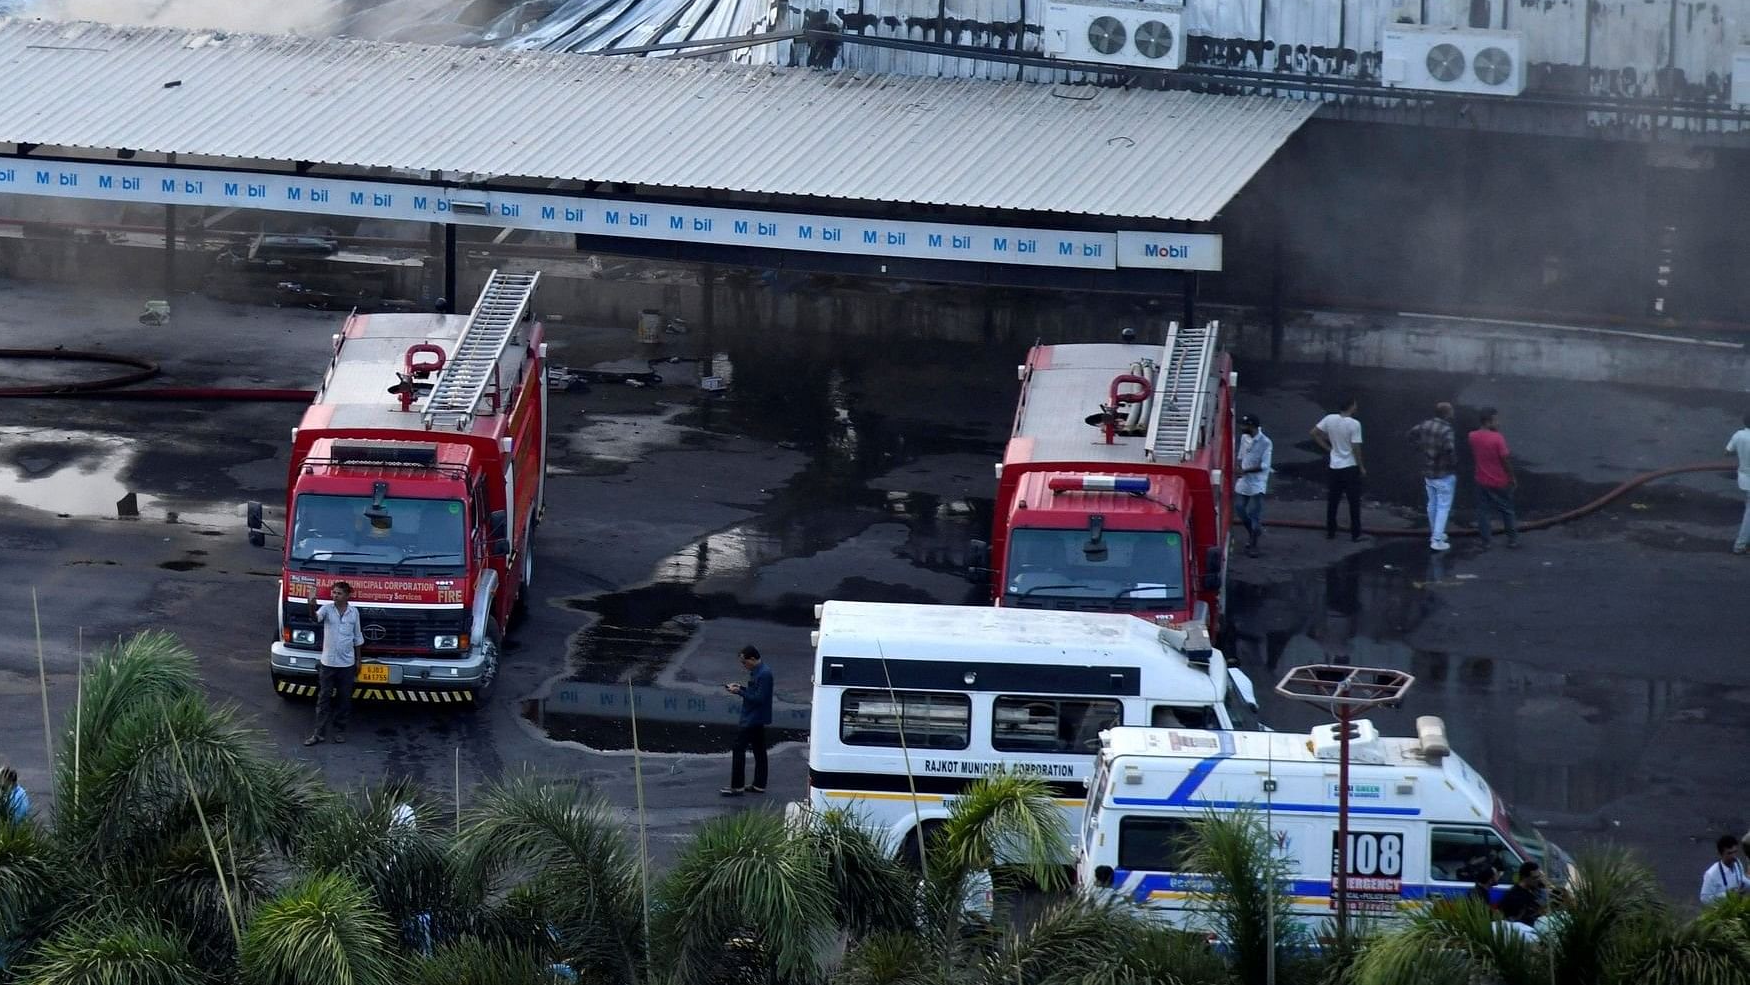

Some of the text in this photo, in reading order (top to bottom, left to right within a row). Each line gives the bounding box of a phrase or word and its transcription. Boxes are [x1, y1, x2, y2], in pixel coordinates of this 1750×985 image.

[36, 171, 78, 186] Mbil
[1145, 243, 1188, 258] Mobil
[384, 581, 435, 592] CORPORATION
[359, 590, 393, 601] Emergency
[394, 592, 423, 601] Services
[437, 590, 463, 603] FIRE
[924, 759, 959, 772] RAJKOT
[960, 761, 1007, 775] MUNICIPAL
[1346, 833, 1402, 875] 108
[1332, 877, 1400, 891] EERGENCY
